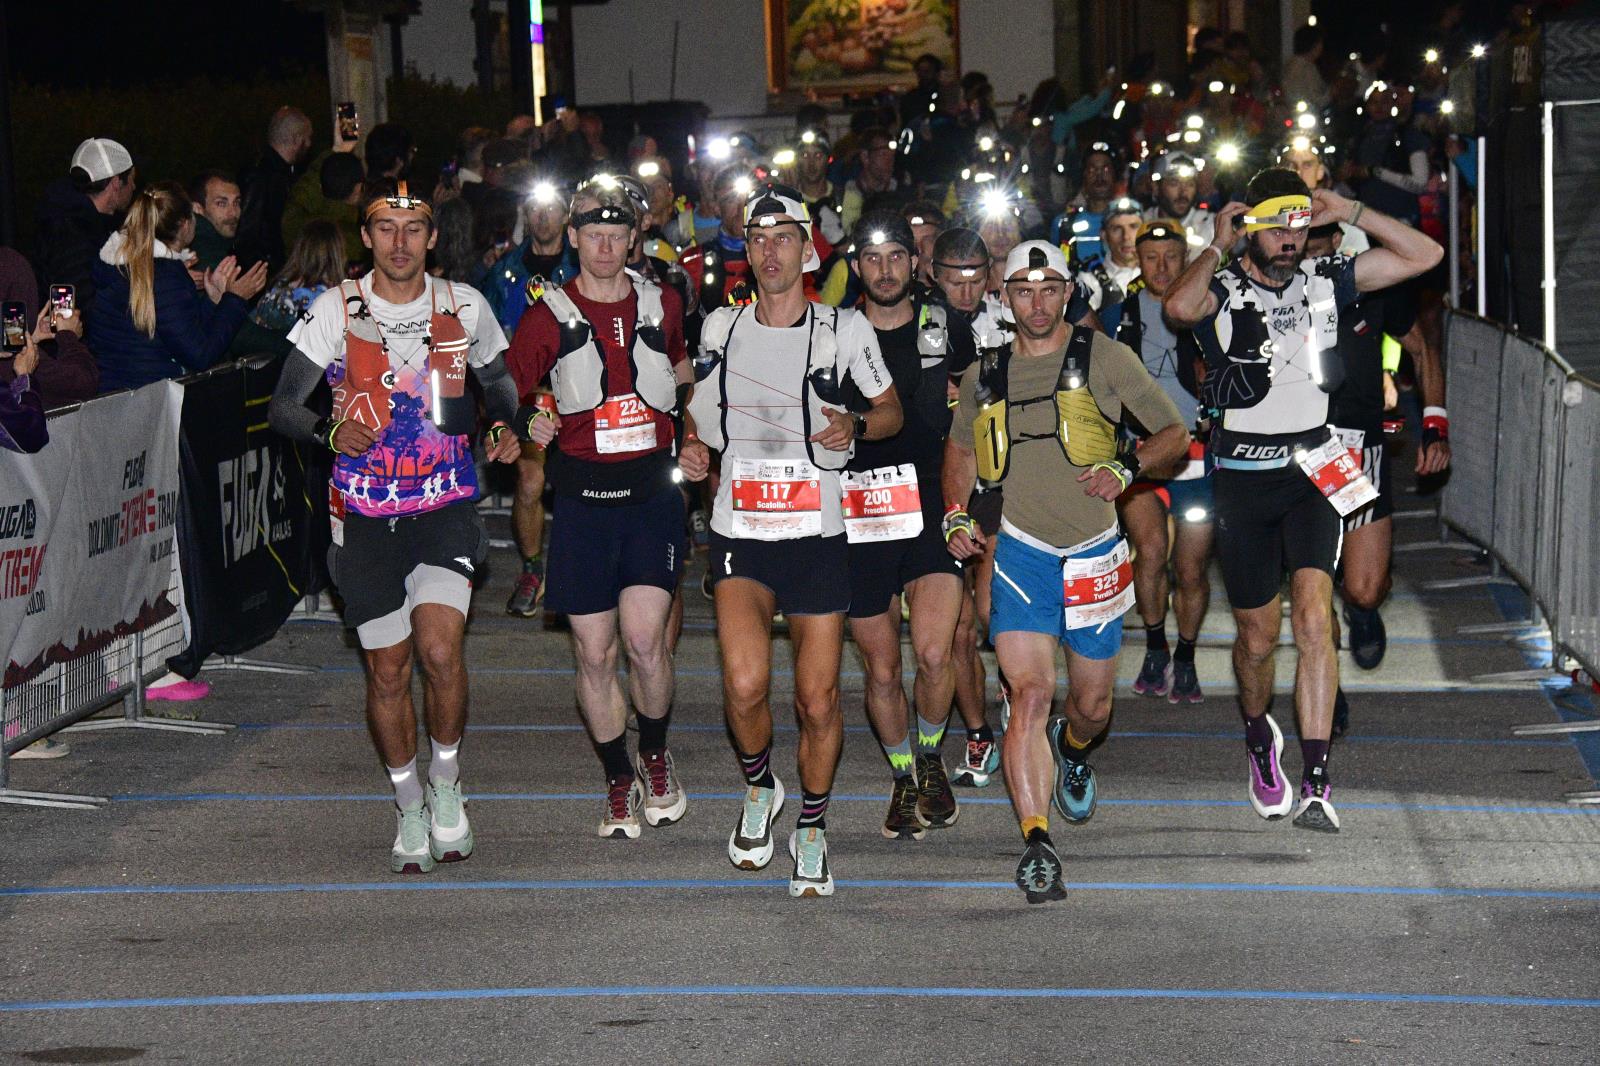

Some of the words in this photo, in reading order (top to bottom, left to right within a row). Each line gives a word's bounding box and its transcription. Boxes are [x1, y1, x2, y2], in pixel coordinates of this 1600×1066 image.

[620, 399, 646, 416] 224
[1231, 443, 1288, 460] FUGA
[582, 488, 631, 499] SALOMON
[760, 483, 791, 500] 117
[863, 489, 892, 506] 200
[217, 446, 271, 569] FUGA
[787, 501, 795, 509] T.
[888, 505, 896, 513] A.
[1093, 570, 1119, 592] 329
